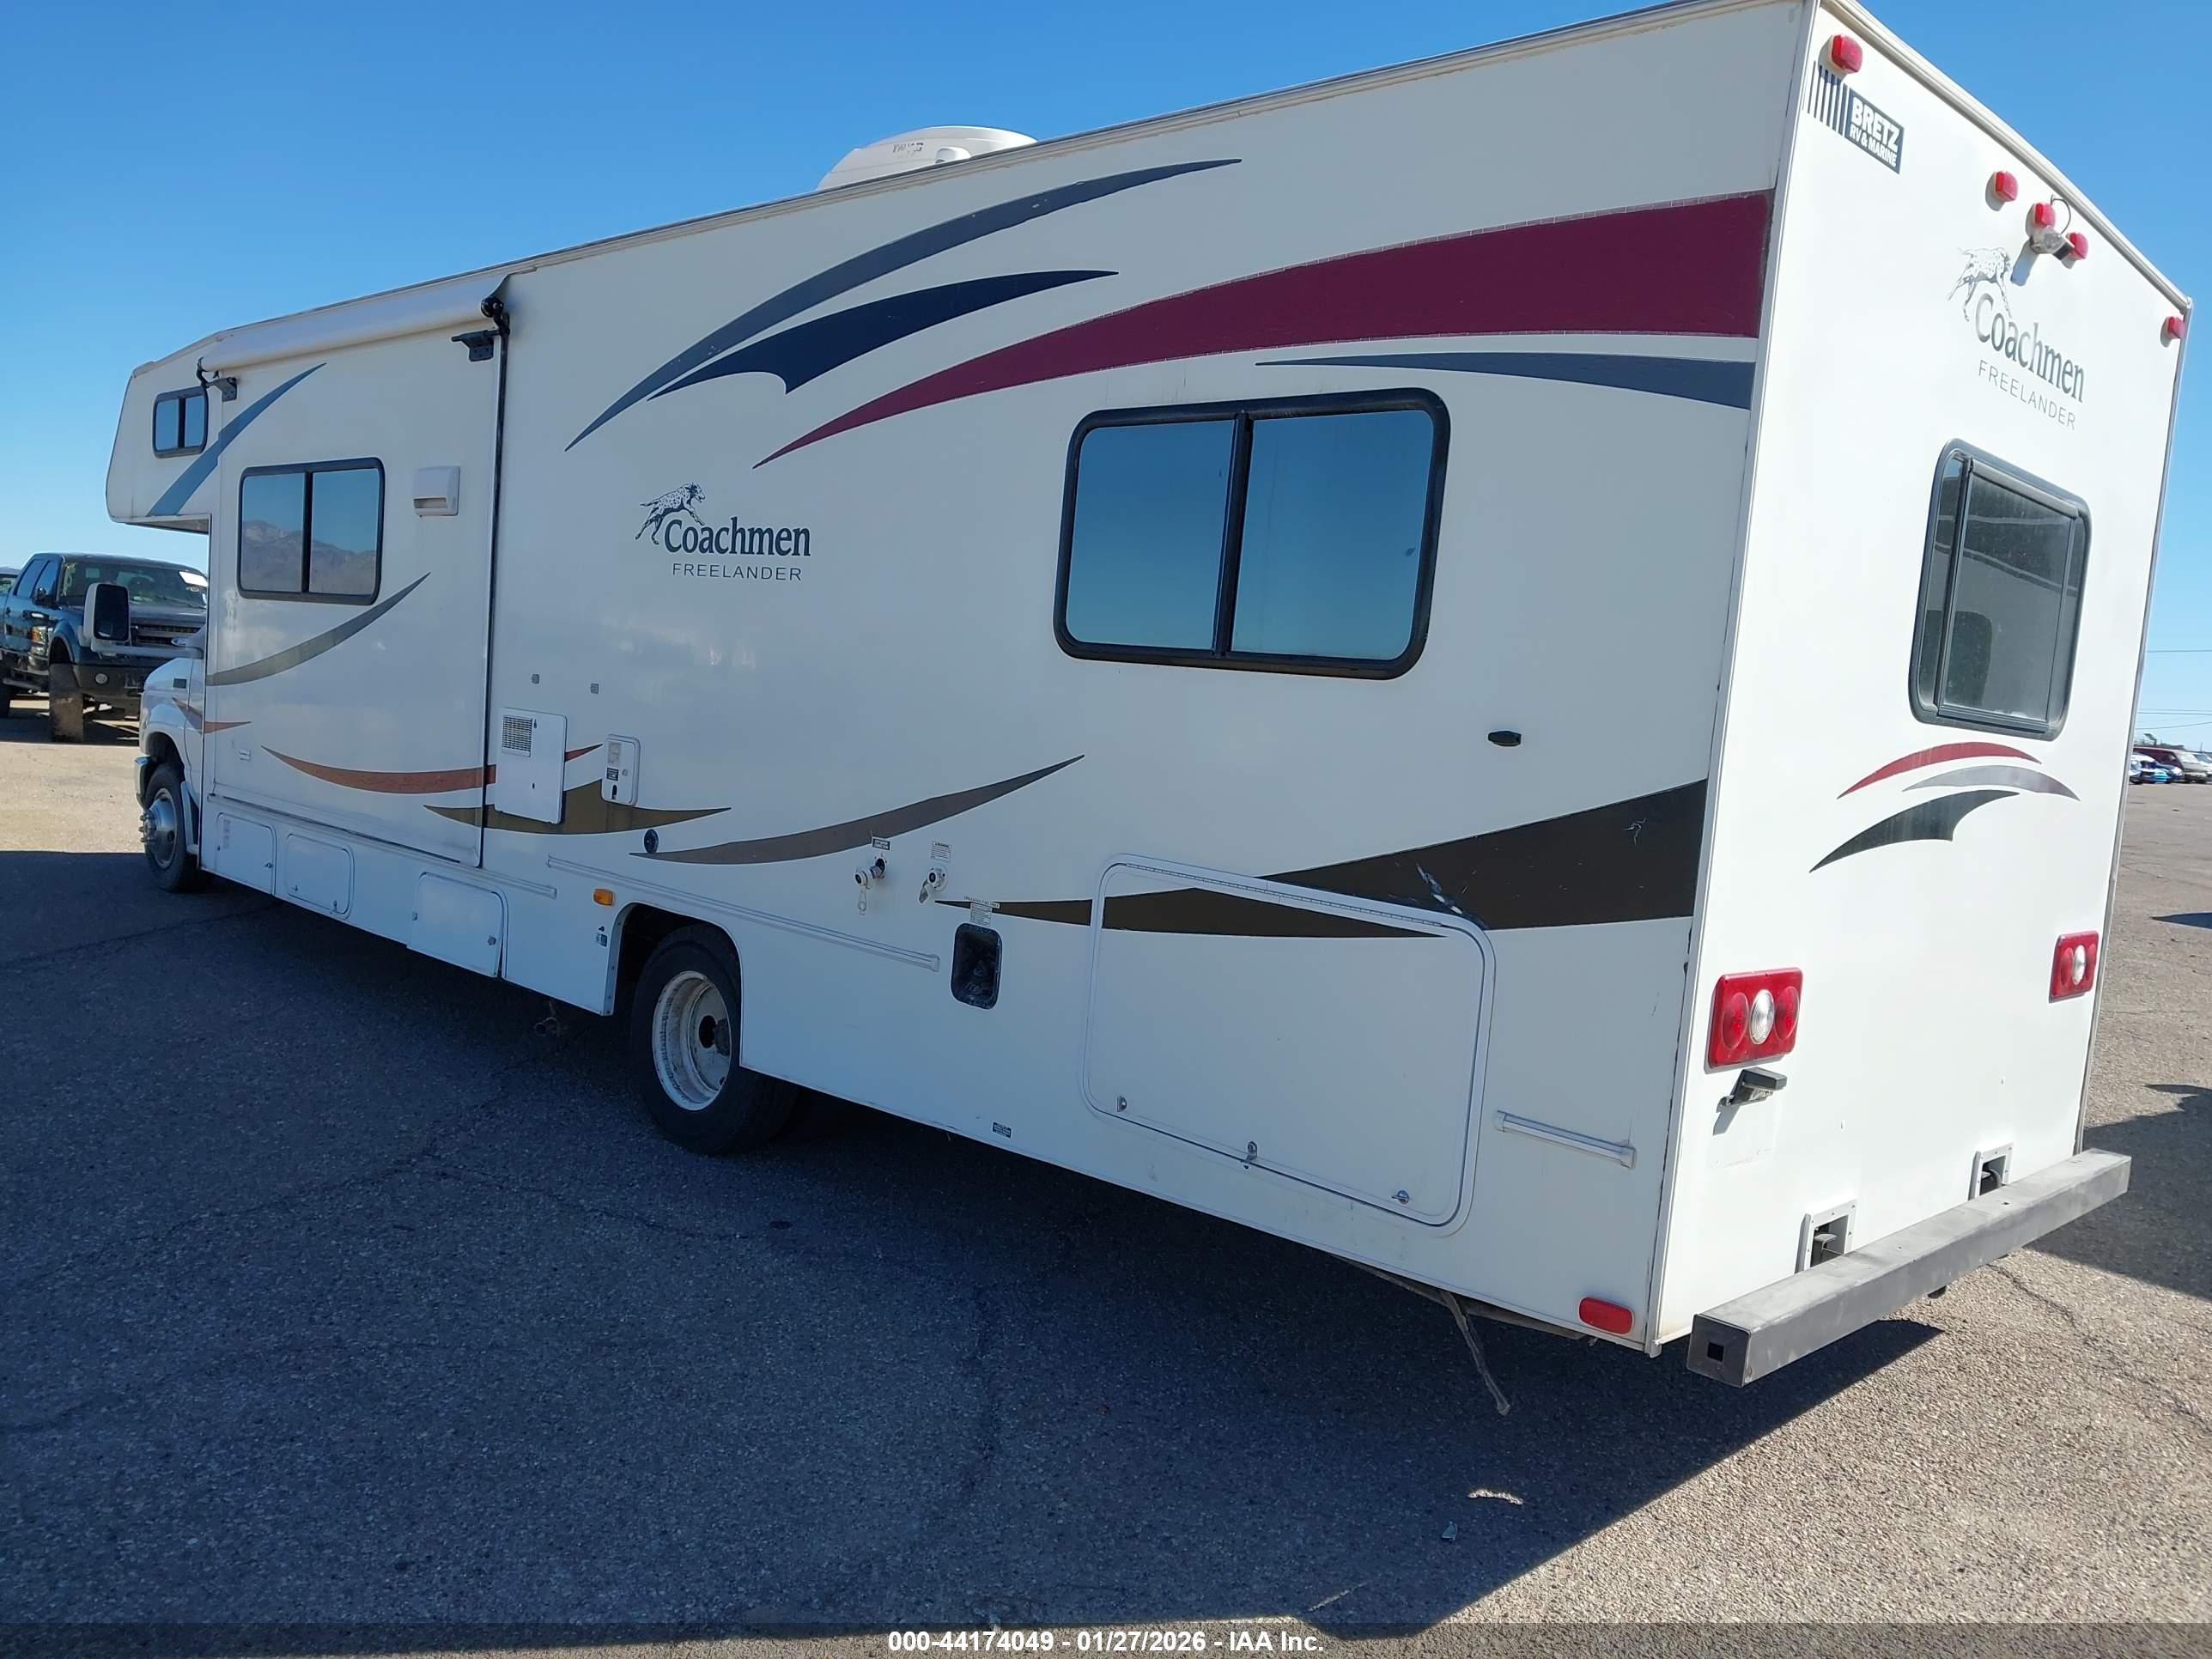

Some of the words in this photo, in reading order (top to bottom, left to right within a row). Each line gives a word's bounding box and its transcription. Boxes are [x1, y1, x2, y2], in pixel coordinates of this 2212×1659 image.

[1850, 124, 1863, 143] RV
[1861, 131, 1869, 148] &
[1868, 137, 1898, 167] MARINE
[1851, 96, 1900, 153] BRETZ
[1976, 293, 2084, 404] Coachmen
[1978, 359, 2075, 430] FREELANDER
[664, 516, 811, 556] Coachmen
[672, 562, 802, 581] FREELANDER
